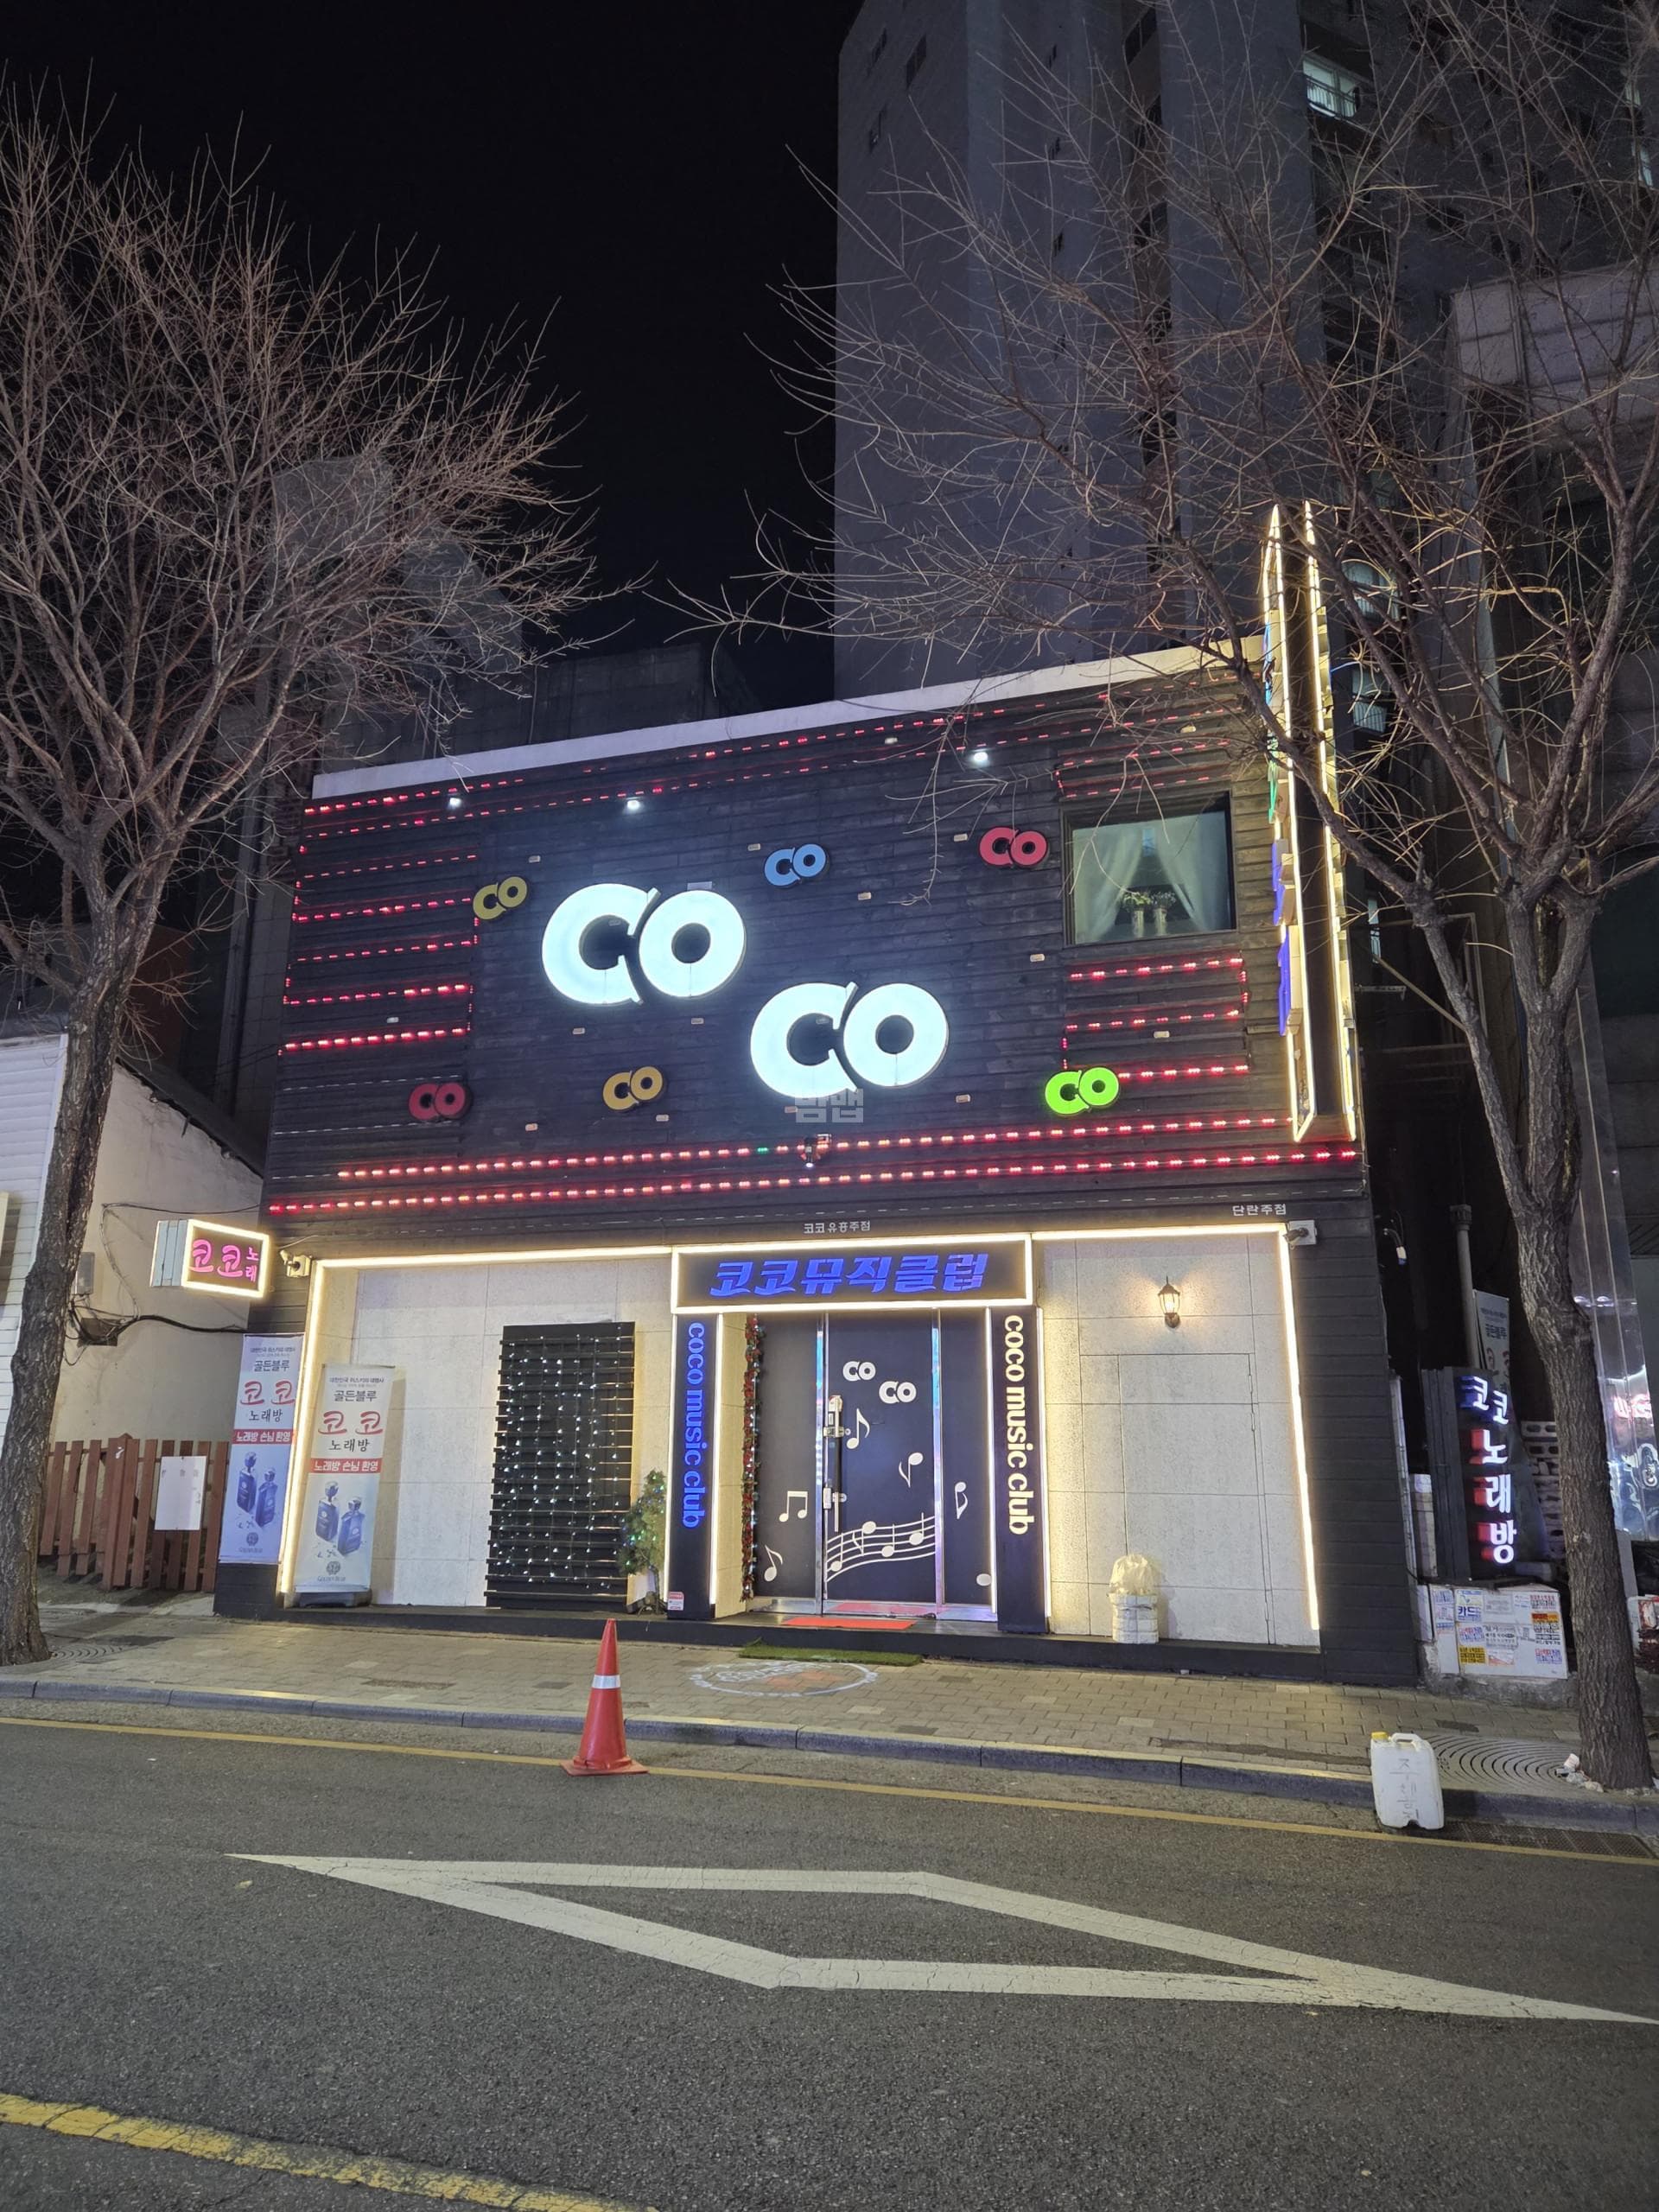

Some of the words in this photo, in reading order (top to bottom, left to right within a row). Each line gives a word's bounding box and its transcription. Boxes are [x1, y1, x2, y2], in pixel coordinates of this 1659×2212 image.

[1232, 1204, 1287, 1217] 단란주점
[188, 1239, 243, 1278] 코코
[245, 1247, 259, 1282] 노래
[709, 1253, 988, 1296] 코코뮤직클럽
[254, 1359, 289, 1372] 골든블루
[687, 1322, 705, 1385] coco
[1004, 1315, 1025, 1382] coco
[249, 1408, 283, 1423] 노래방
[334, 1389, 378, 1402] 골든블루
[237, 1431, 259, 1442] 노래방
[260, 1431, 276, 1442] 손님
[276, 1431, 291, 1442] 환영
[328, 1439, 371, 1452] 노래방
[684, 1389, 708, 1466] music
[1006, 1386, 1034, 1468] music
[314, 1460, 340, 1471] 노래방
[342, 1460, 360, 1471] 손님
[361, 1460, 378, 1471] 환영
[682, 1471, 706, 1529] club
[1007, 1472, 1035, 1535] club
